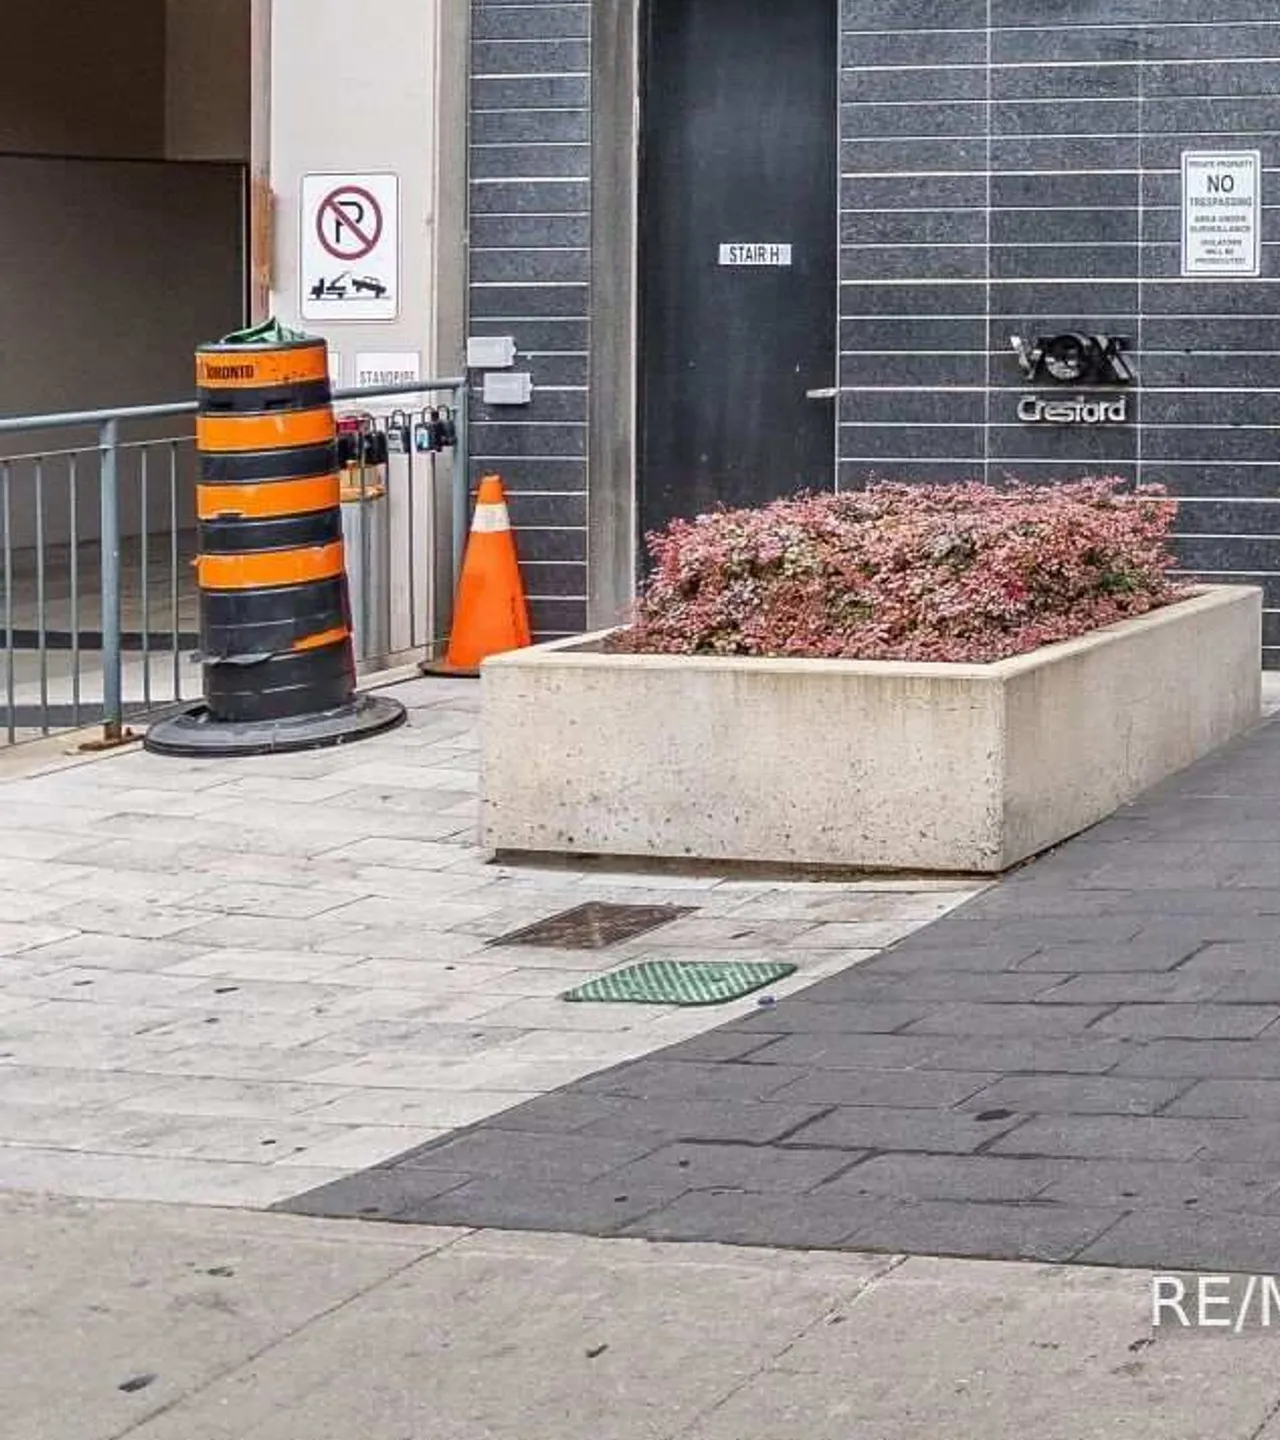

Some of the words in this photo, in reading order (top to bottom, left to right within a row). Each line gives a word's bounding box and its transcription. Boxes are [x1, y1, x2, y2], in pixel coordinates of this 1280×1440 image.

[1207, 174, 1234, 193] NO
[729, 245, 766, 262] STAIR
[770, 246, 779, 262] H
[1017, 395, 1126, 422] Cresford
